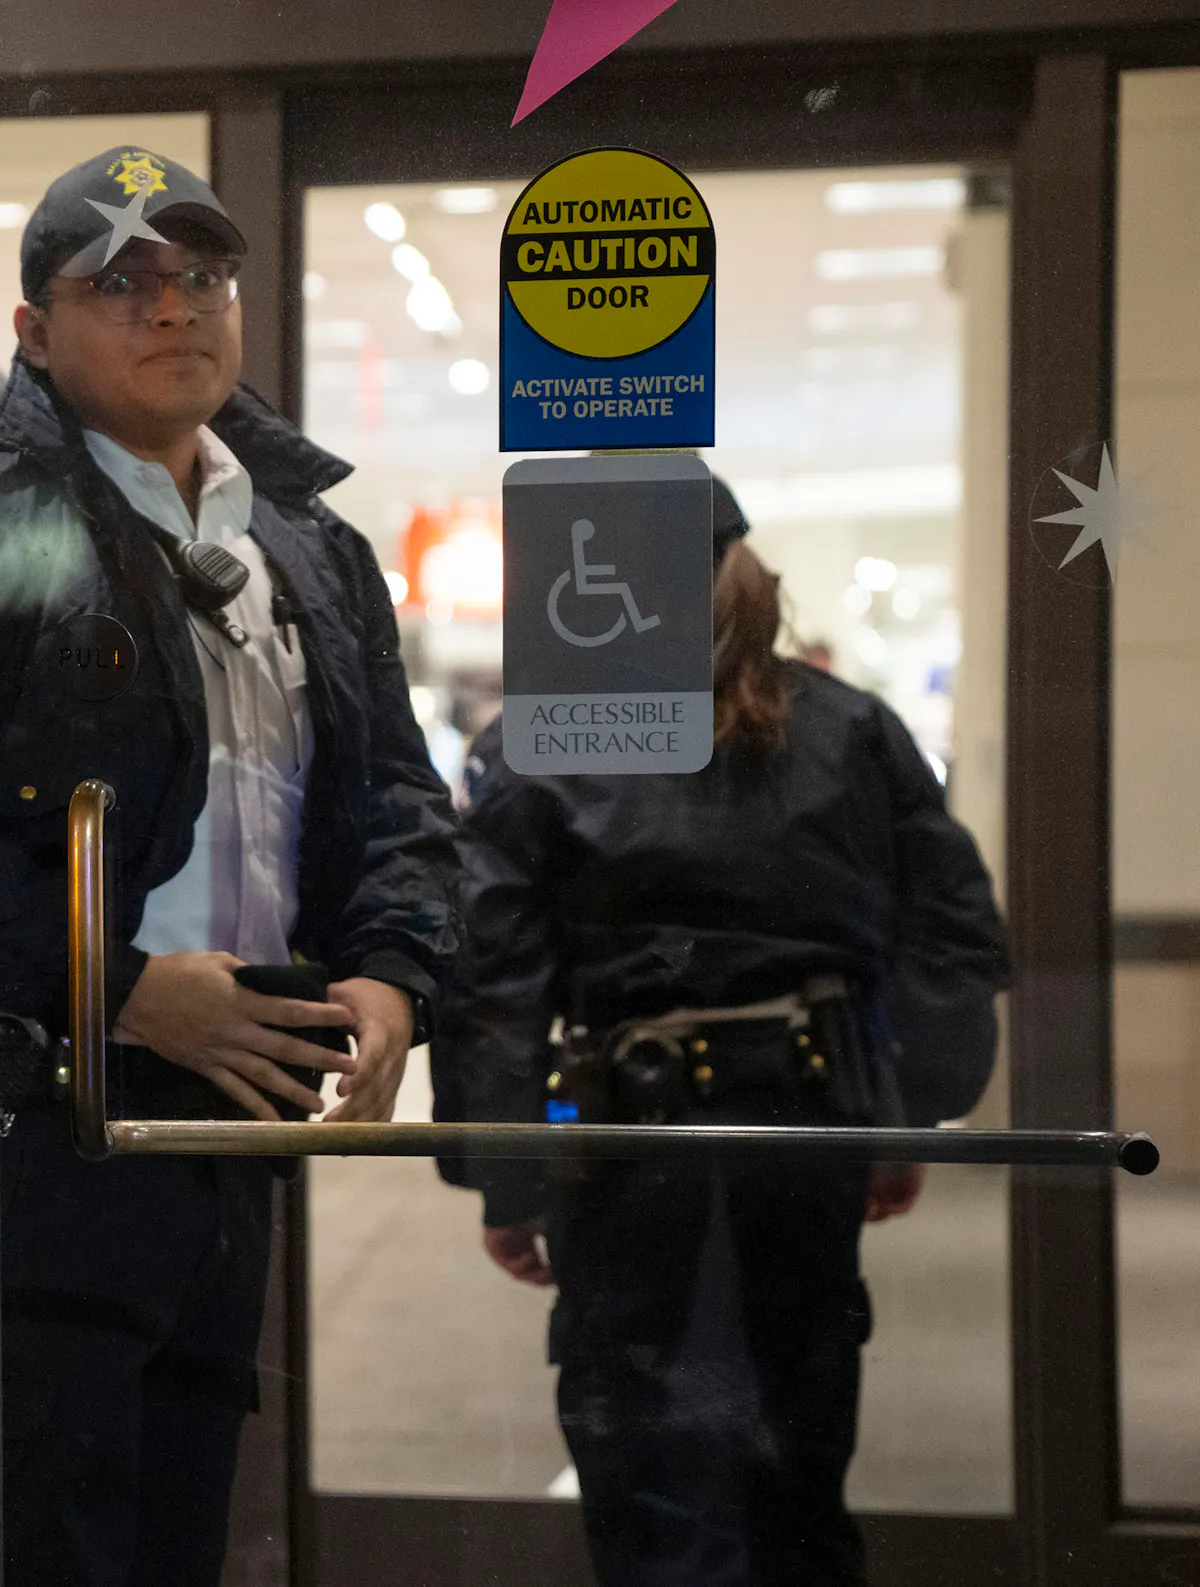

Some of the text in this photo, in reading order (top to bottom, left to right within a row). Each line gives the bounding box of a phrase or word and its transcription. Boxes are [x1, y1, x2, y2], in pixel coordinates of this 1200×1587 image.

[522, 196, 692, 226] AUTOMATIC
[517, 235, 698, 273] CAUTION
[567, 285, 649, 310] DOOR
[511, 374, 705, 398] ACTIVATE SWITCH
[539, 398, 674, 419] TO OPERATE
[58, 648, 126, 668] PULL
[530, 702, 684, 726] ACCESSIBLE
[535, 731, 679, 755] ENTRANCE
